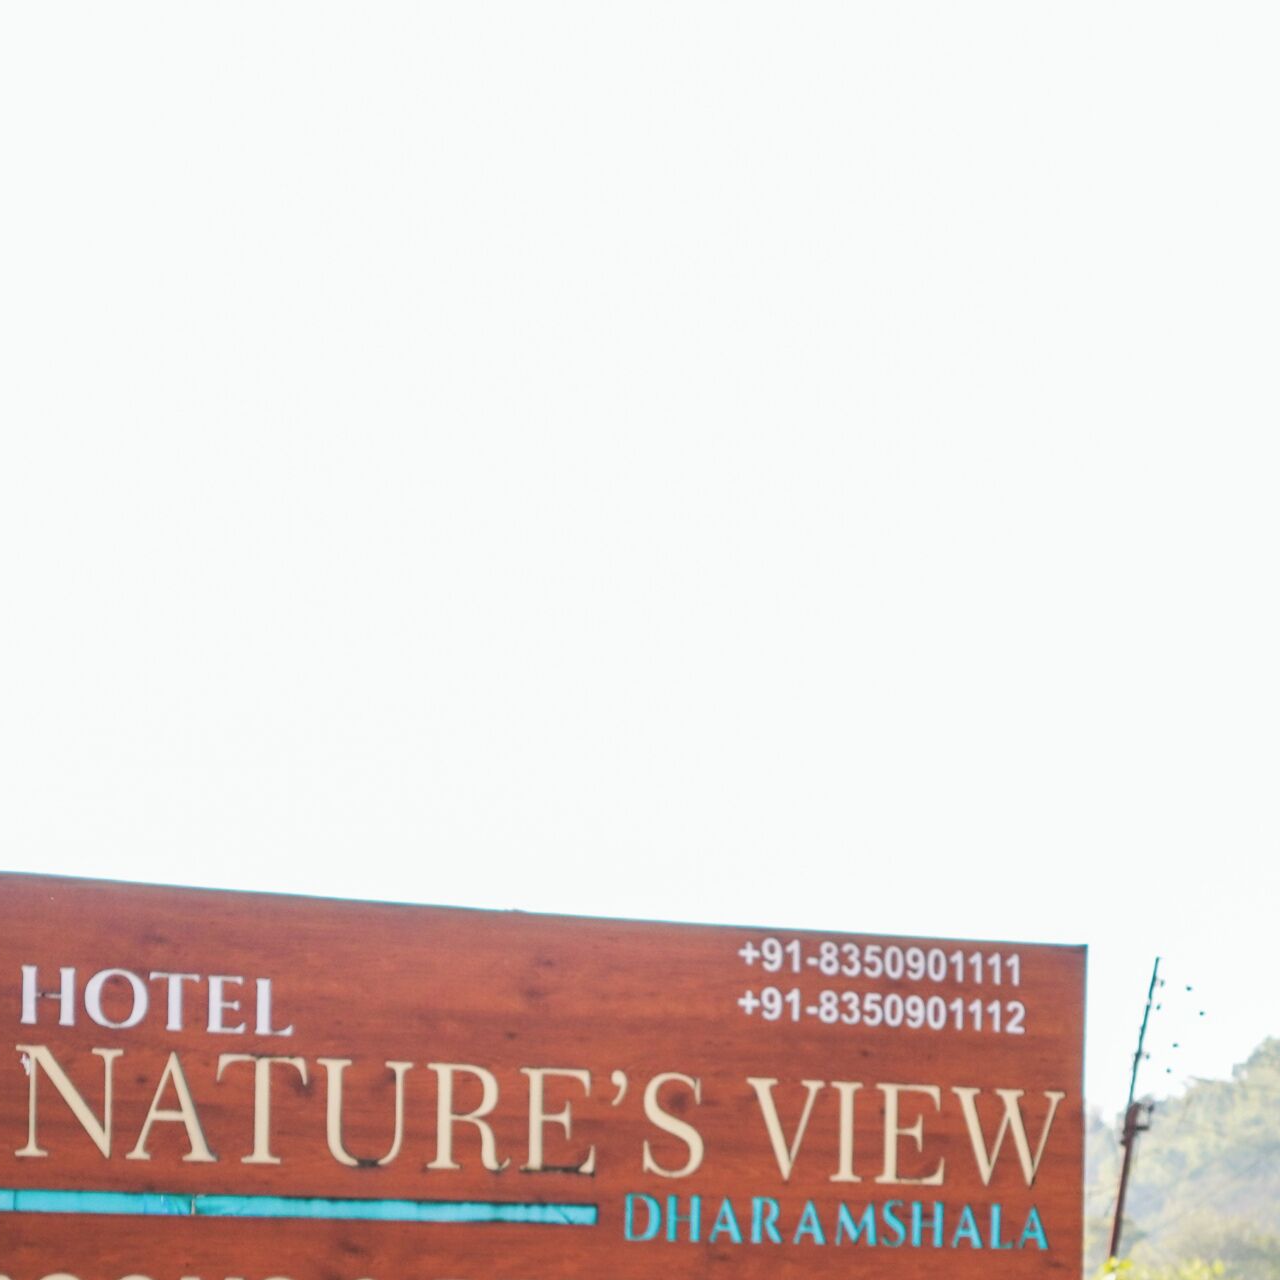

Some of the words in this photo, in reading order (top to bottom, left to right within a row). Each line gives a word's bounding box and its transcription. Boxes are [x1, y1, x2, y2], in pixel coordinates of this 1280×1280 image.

[738, 937, 1021, 986] +91-8350901111
[20, 965, 294, 1036] HOTEL
[738, 986, 1026, 1035] +91-8350901112
[14, 1043, 705, 1179] NATURE'S
[746, 1077, 1066, 1187] VIEW
[623, 1193, 1049, 1251] DHARAMSHALA
